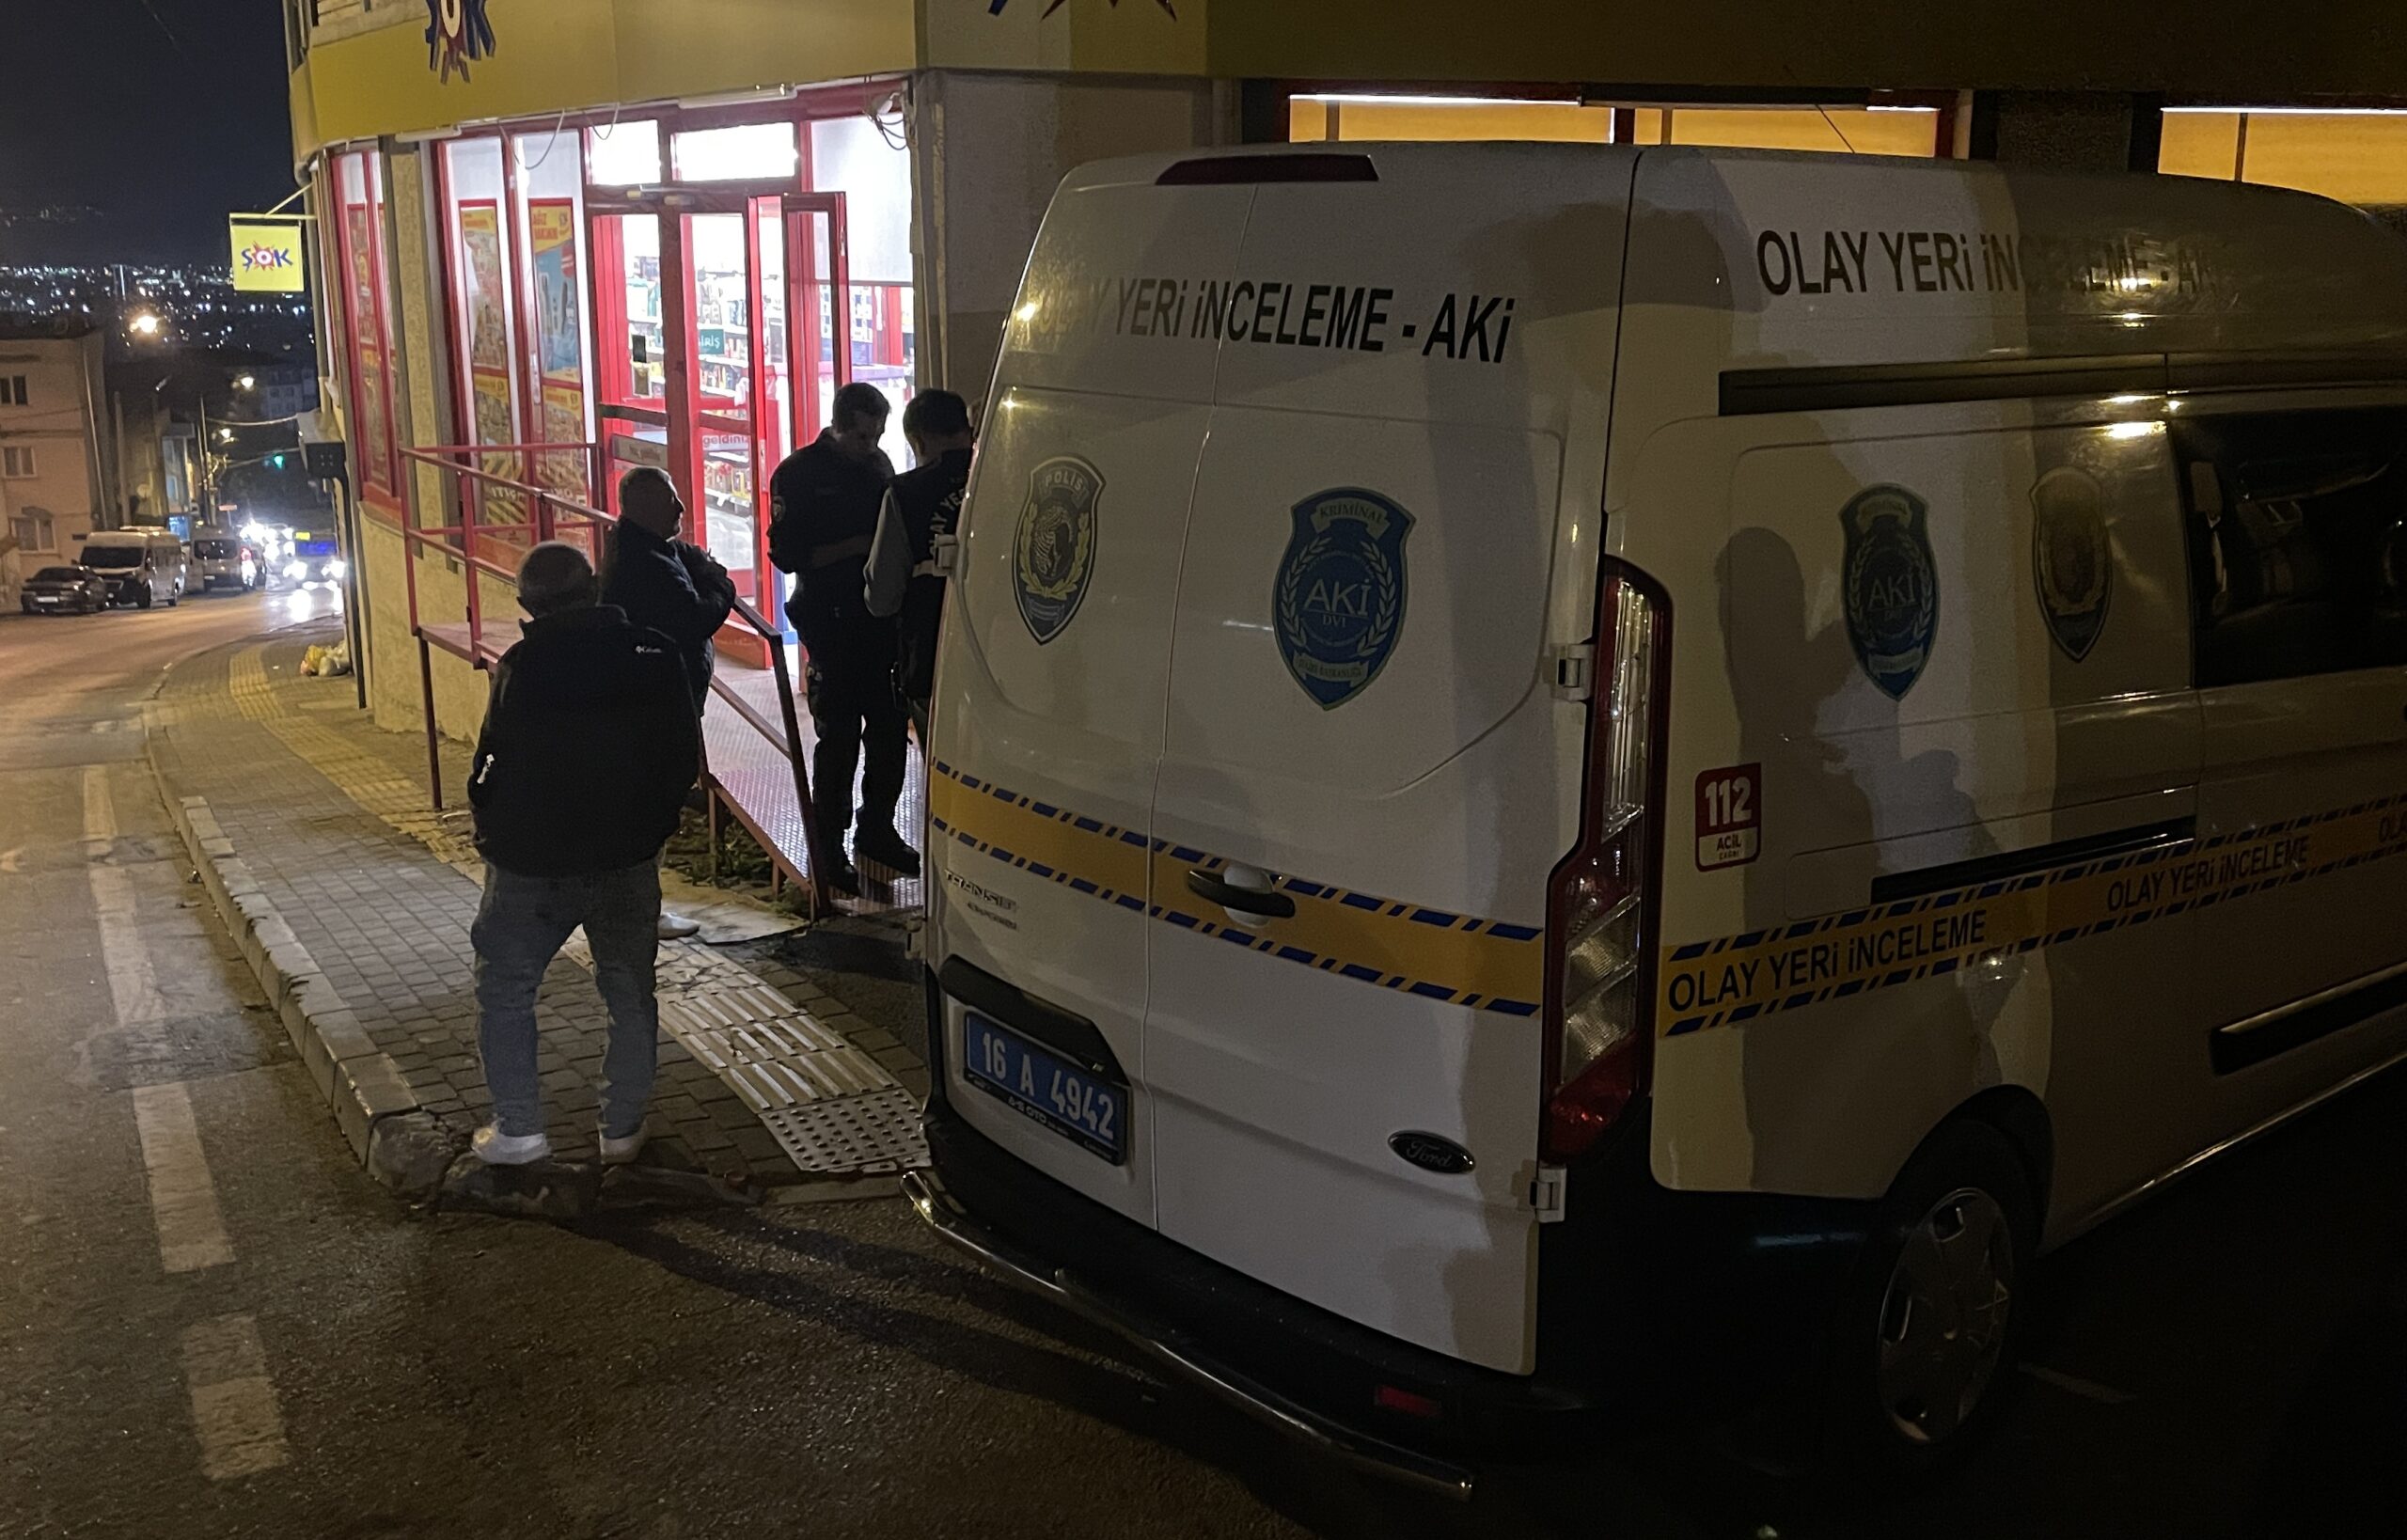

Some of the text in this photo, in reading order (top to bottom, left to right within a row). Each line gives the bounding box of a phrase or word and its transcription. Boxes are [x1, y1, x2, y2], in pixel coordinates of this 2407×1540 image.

[1756, 230, 1868, 295] OLAY
[1705, 776, 1753, 827] 112
[2107, 870, 2165, 912] OLAY
[1668, 958, 1760, 1013] OLAY
[983, 1031, 1114, 1140] 16 A 4942
[1406, 1139, 1454, 1168] Ford
